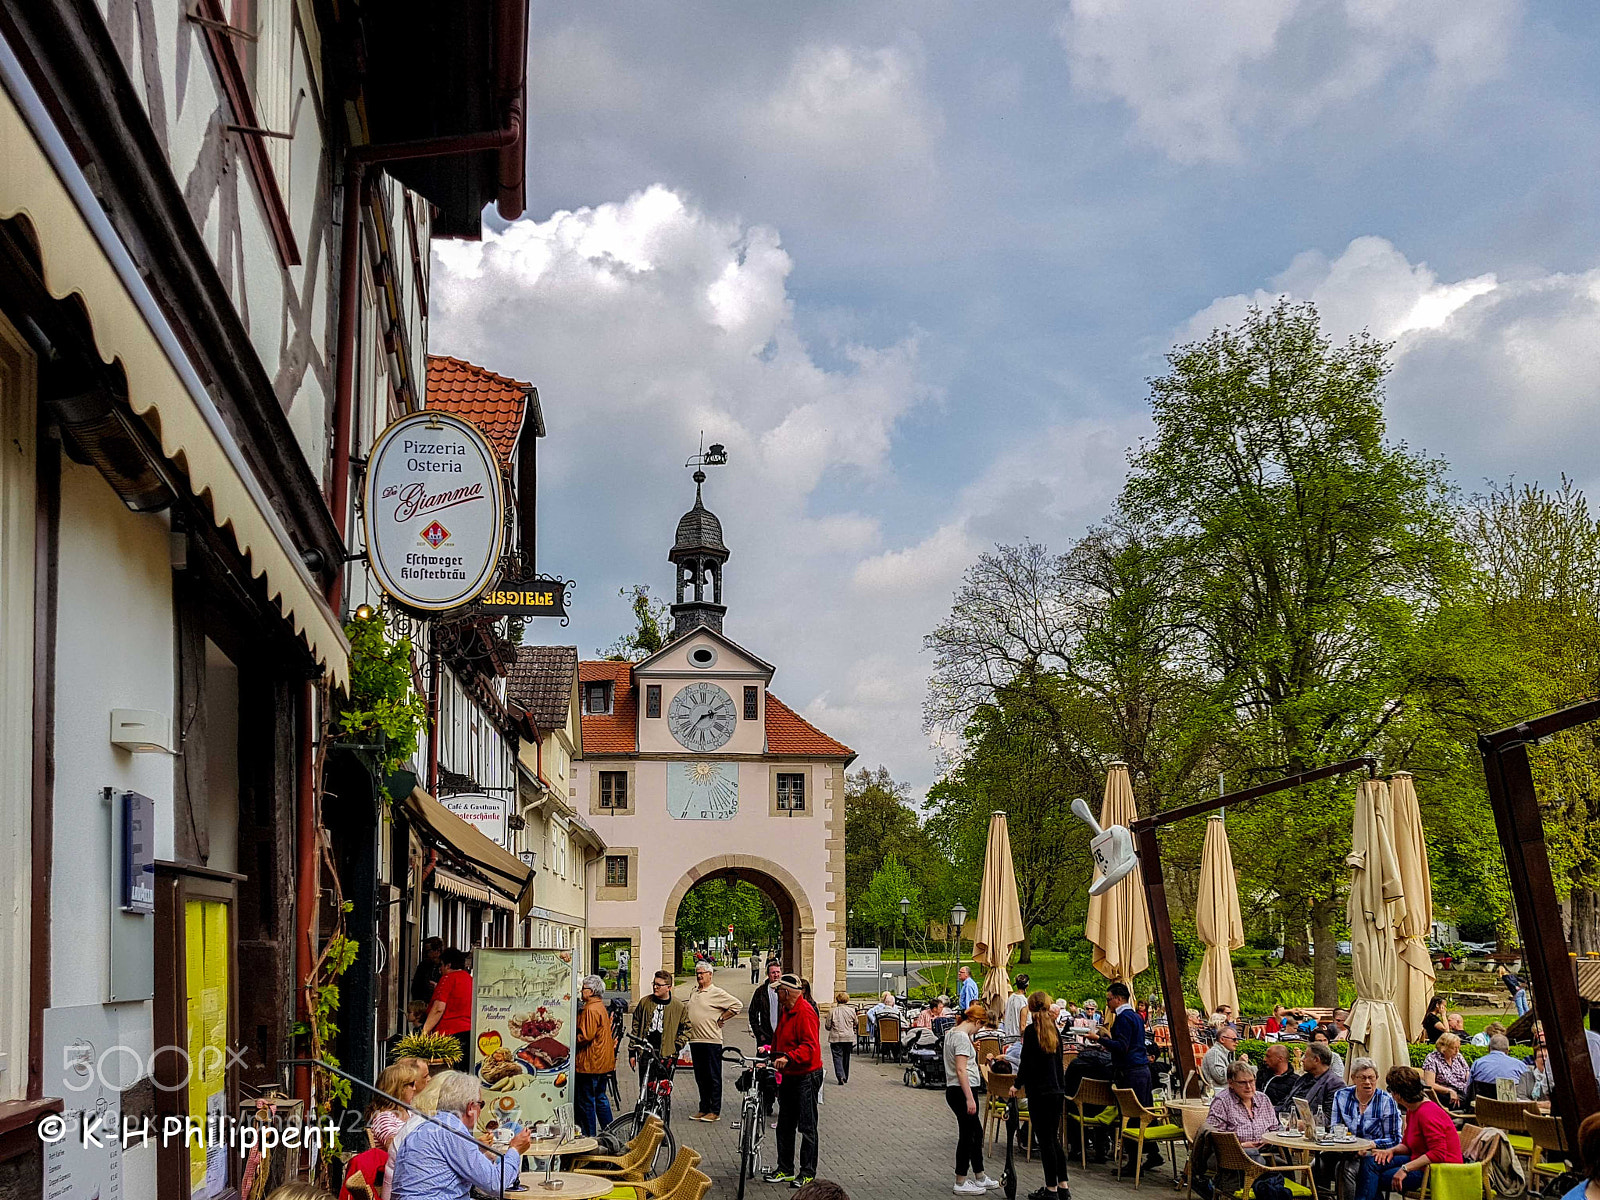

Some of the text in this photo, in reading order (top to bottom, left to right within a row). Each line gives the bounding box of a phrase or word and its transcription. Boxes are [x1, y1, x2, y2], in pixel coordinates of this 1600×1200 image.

[404, 440, 465, 455] Pizzeria
[407, 458, 462, 472] Osteria
[394, 482, 484, 523] Giamma
